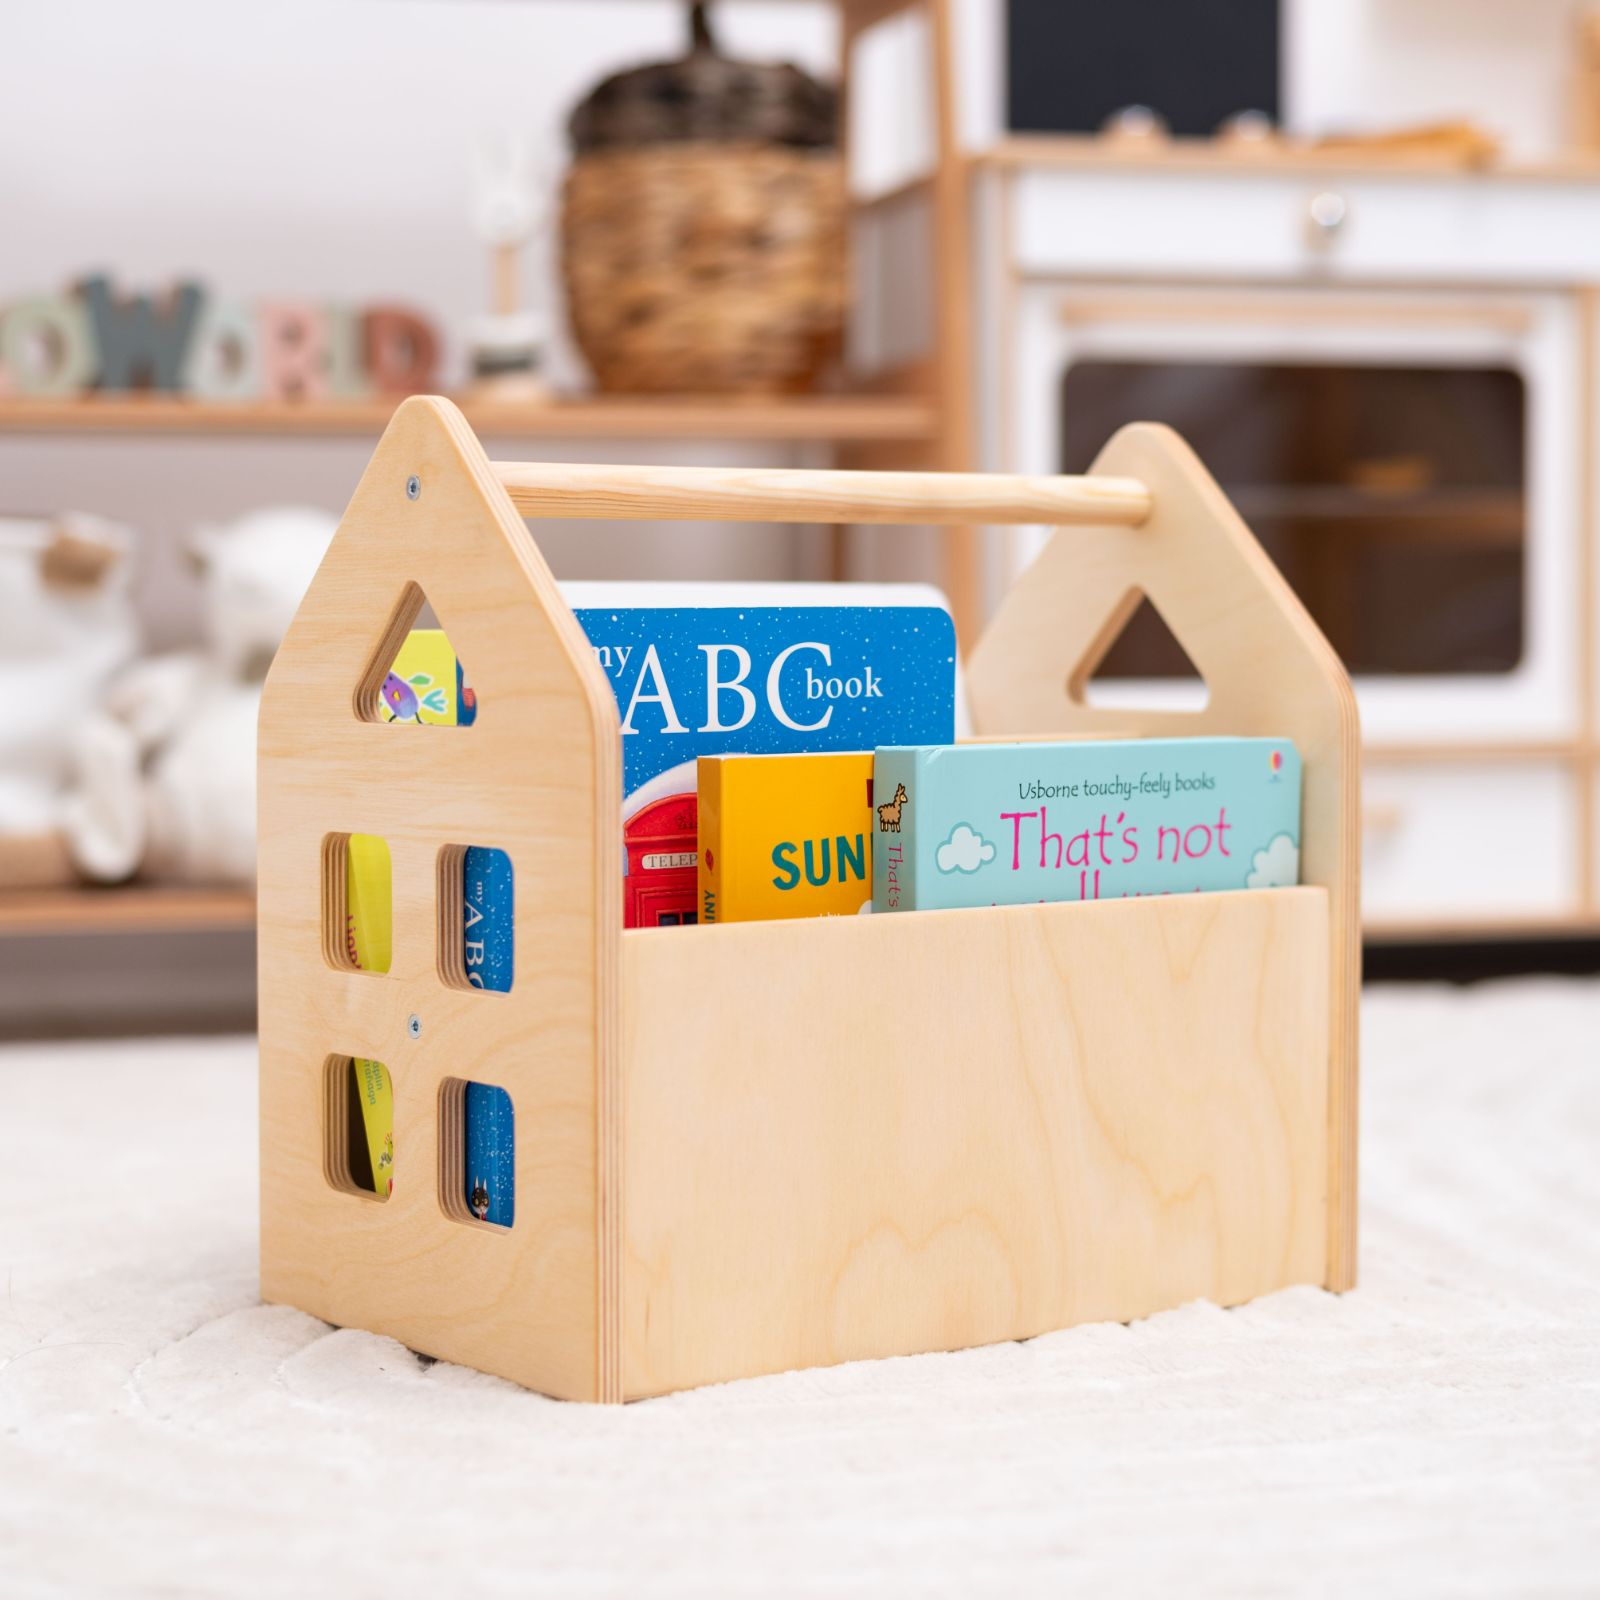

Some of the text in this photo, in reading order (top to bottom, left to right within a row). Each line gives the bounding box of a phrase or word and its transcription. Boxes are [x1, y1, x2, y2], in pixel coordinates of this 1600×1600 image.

[592, 641, 884, 735] my ABC book
[1018, 772, 1217, 801] Usborne touchy-feely books
[648, 853, 697, 868] TELEP
[771, 832, 873, 891] SUN
[1000, 806, 1232, 871] That's not
[469, 881, 483, 905] my
[888, 842, 904, 908] That's
[704, 889, 716, 923] INY
